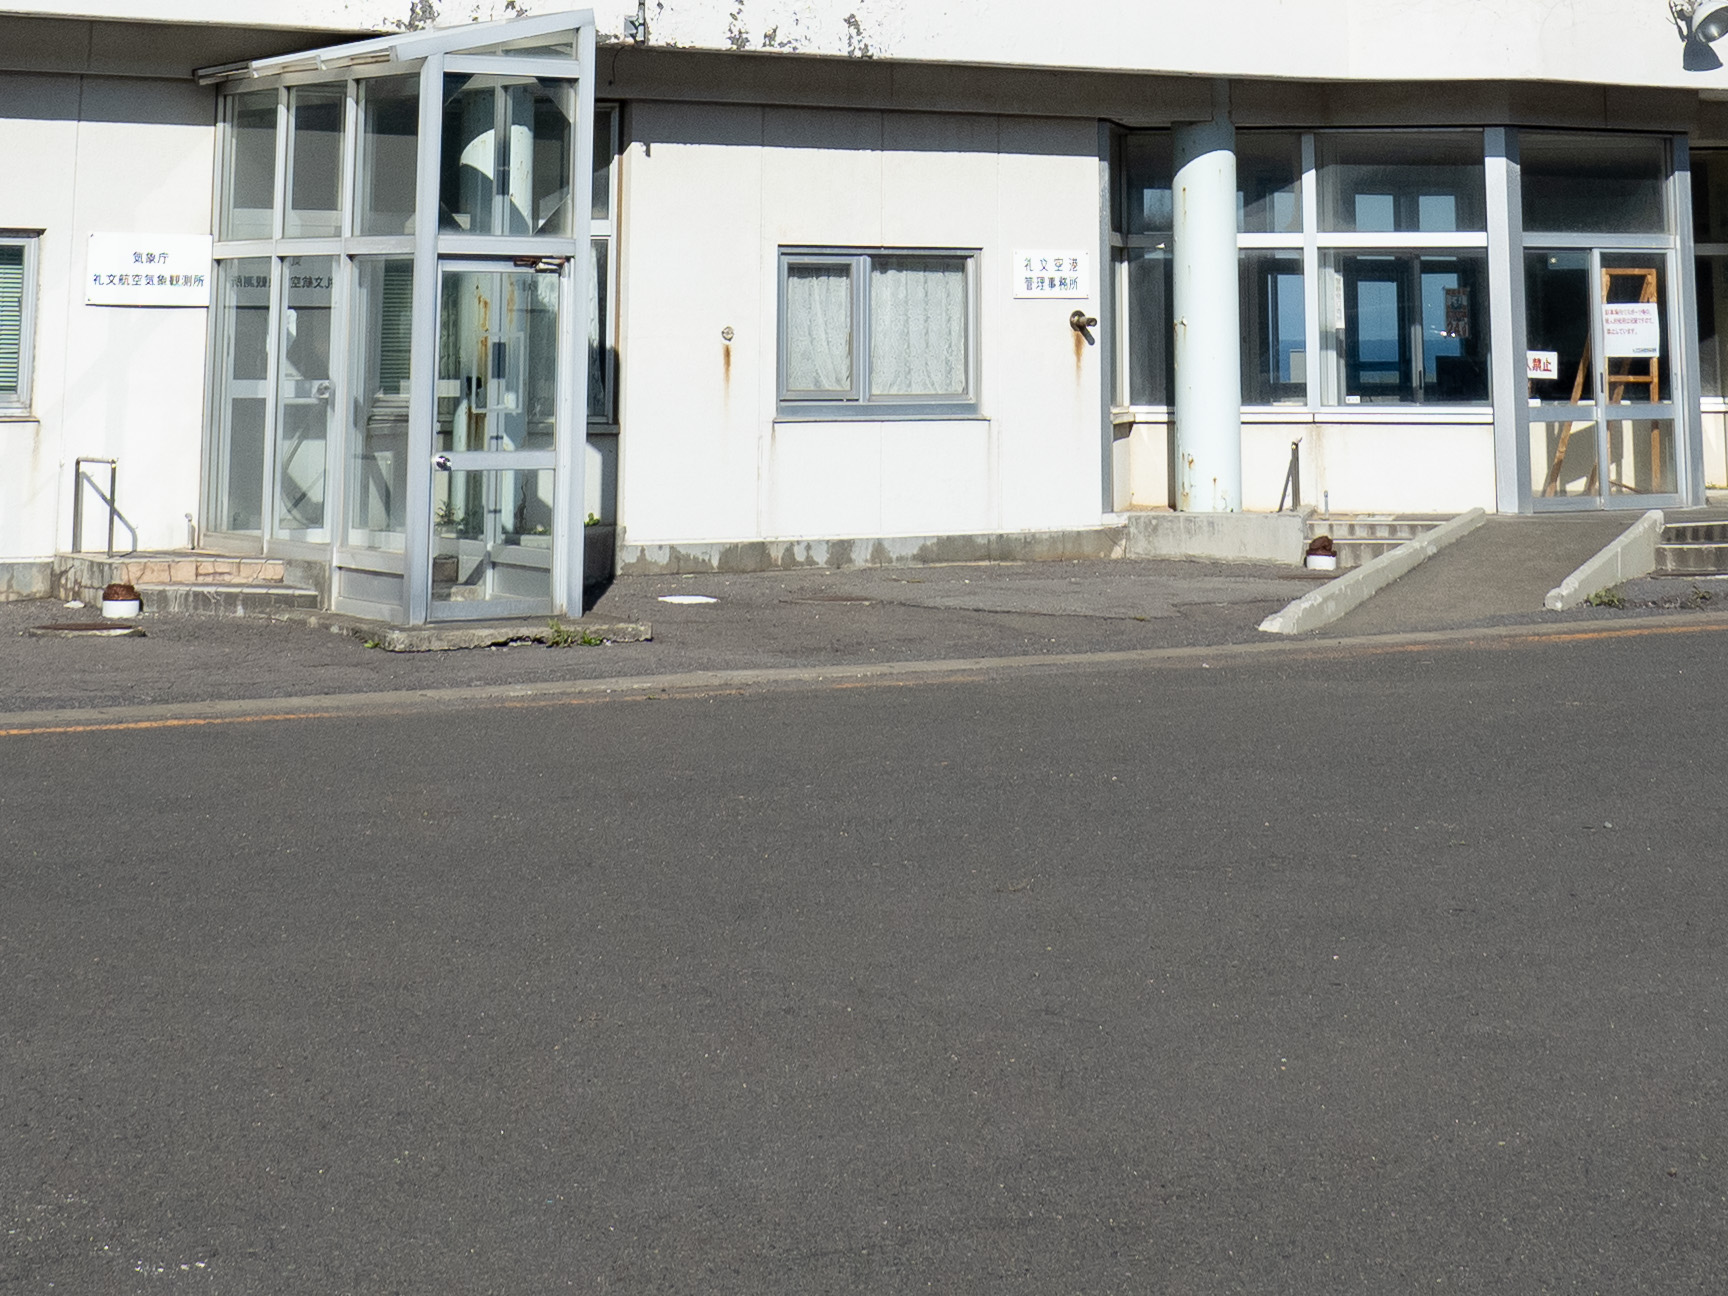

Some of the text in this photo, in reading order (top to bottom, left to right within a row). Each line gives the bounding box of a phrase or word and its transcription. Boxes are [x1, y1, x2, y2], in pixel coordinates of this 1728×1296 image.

[133, 251, 169, 264] 気象庁
[1024, 257, 1079, 272] 礼文空港
[93, 273, 205, 288] 礼文航空気象観測所
[1024, 276, 1079, 291] 管理事務所
